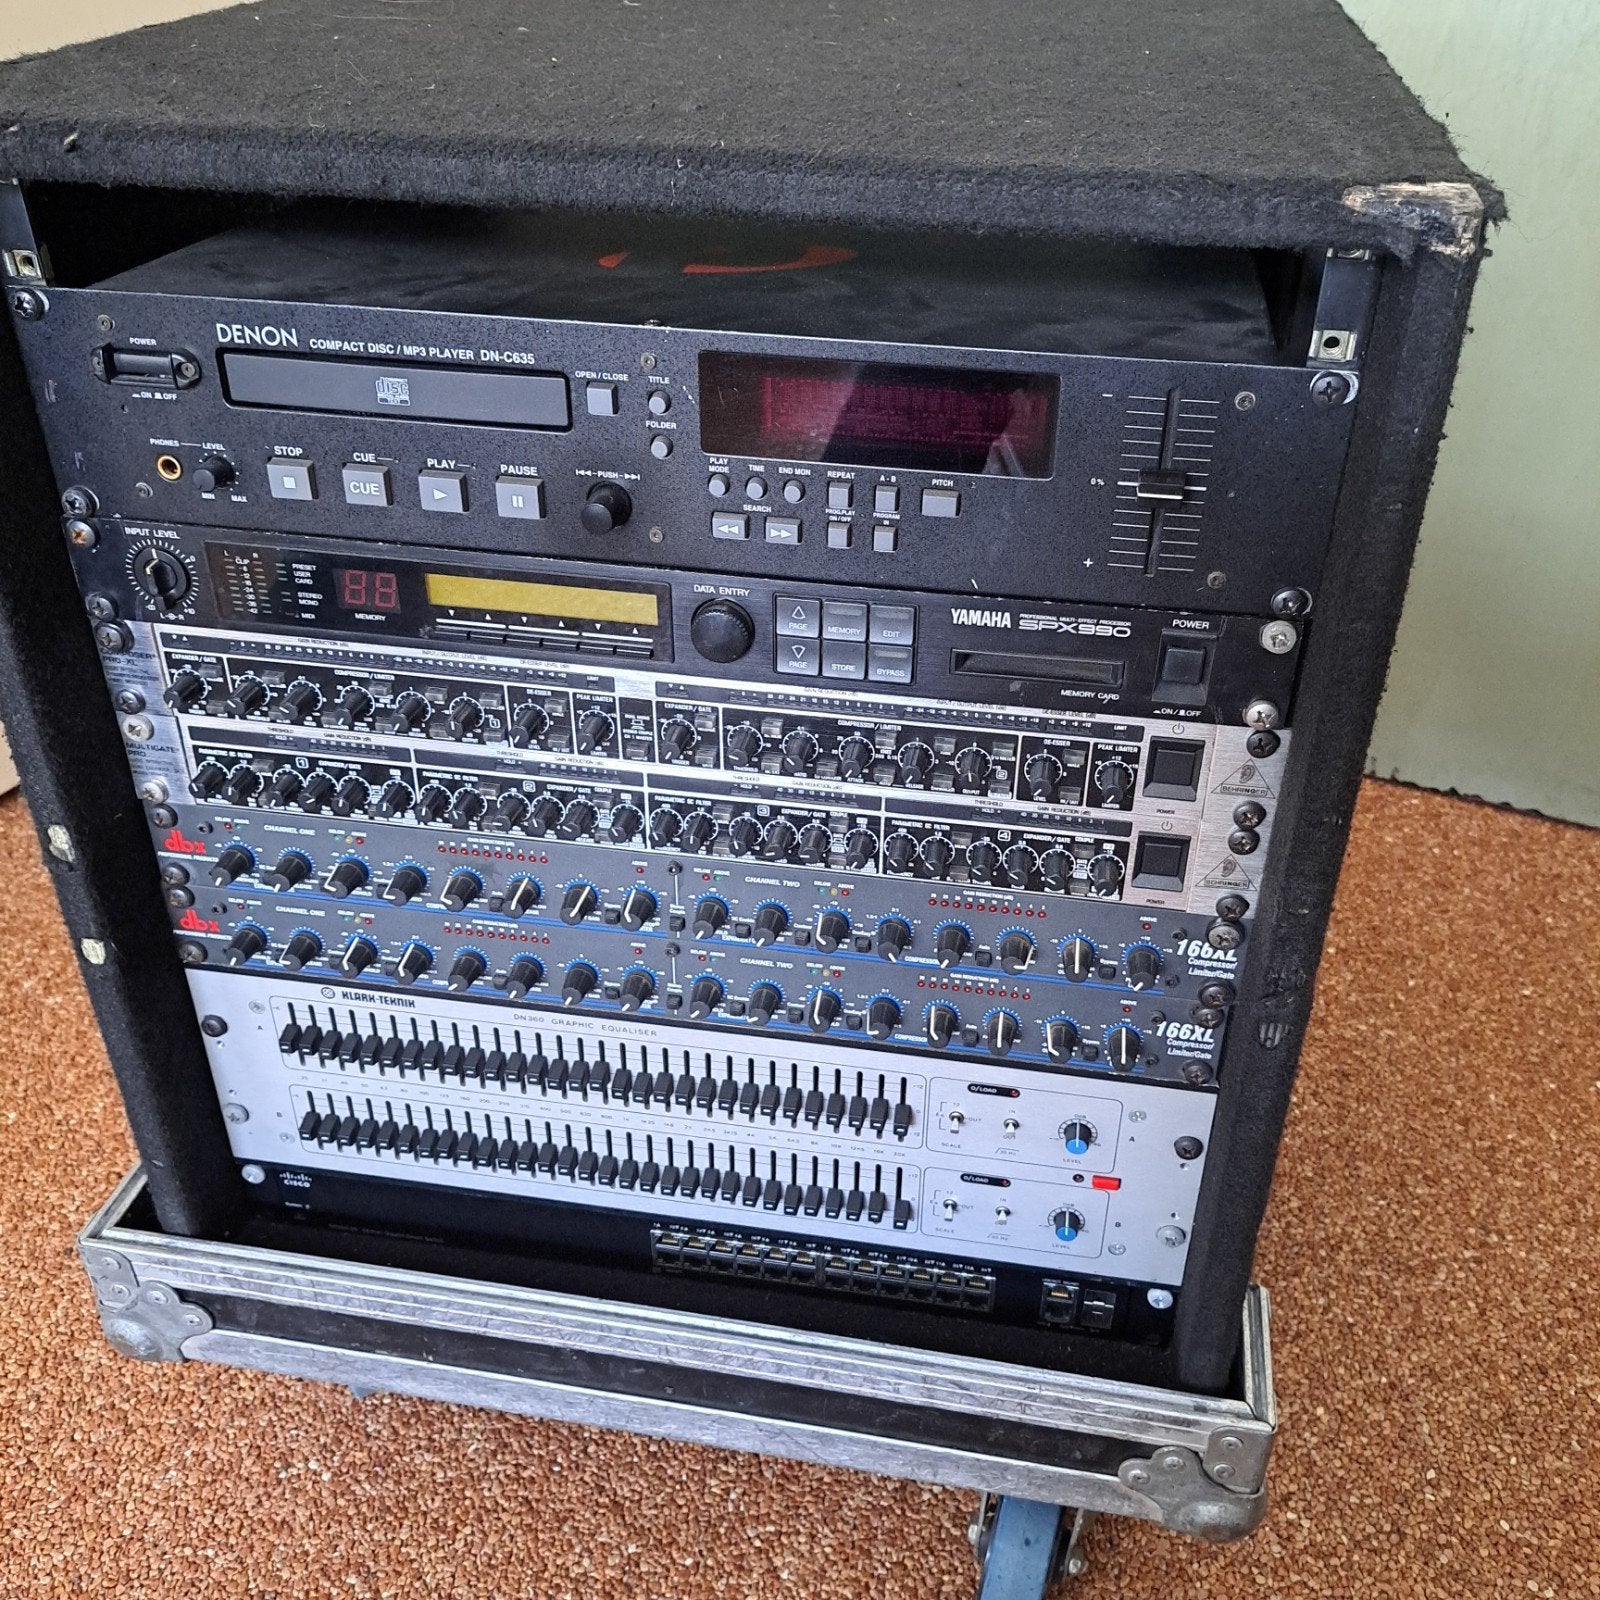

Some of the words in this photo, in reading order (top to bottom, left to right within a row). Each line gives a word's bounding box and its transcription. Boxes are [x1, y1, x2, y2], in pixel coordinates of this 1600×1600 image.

[129, 336, 157, 346] POWER
[216, 322, 299, 347] DENON
[310, 338, 364, 353] COMPACT
[368, 342, 394, 355] DISC
[403, 346, 427, 358] MP3
[429, 347, 474, 361] PLAYER
[480, 349, 535, 365] DN-C635
[575, 370, 597, 379] OPEN
[603, 372, 629, 382] CLOSE
[648, 375, 670, 385] TITLE
[141, 391, 152, 399] ON
[163, 393, 178, 401] OFF
[645, 420, 677, 430] FOLDER
[150, 438, 180, 447] PHONES
[202, 442, 225, 451] LEVEL
[274, 445, 303, 457] STOP
[353, 452, 376, 463] CUE
[709, 457, 728, 466] PLAY
[427, 458, 455, 471] PLAY
[708, 465, 729, 474] MODE
[748, 464, 765, 473] TIME
[500, 464, 538, 477] PAUSE
[597, 471, 619, 480] PUSH
[778, 466, 793, 475] END
[794, 467, 811, 476] MON
[827, 470, 855, 480] REPEAT
[349, 481, 380, 496] CUE
[931, 479, 954, 488] PITCH
[202, 492, 215, 500] MIN
[231, 495, 247, 503] MAX
[743, 503, 772, 514] SEARCH
[872, 511, 900, 520] PROGRAM
[125, 527, 150, 537] INPUT
[153, 530, 180, 540] LEVEL
[291, 562, 317, 572] PRESET
[293, 570, 311, 578] USER
[294, 577, 313, 585] CARD
[297, 591, 323, 600] STEREO
[693, 584, 716, 594] DATA
[719, 586, 750, 598] ENTRY
[298, 598, 319, 606] MONO
[354, 613, 386, 622] MEMORY
[951, 607, 1012, 629] YAMAHA
[788, 622, 808, 631] PAGE
[1018, 619, 1132, 639] SPX990
[1172, 618, 1210, 630] POWER
[827, 626, 861, 636] MEMORY
[882, 630, 901, 638] EDIT
[788, 660, 808, 669] PAGE
[831, 663, 856, 672] STORE
[876, 668, 905, 677] BYPASS
[1061, 689, 1096, 699] MEMORY
[1097, 691, 1120, 701] CARD
[1160, 707, 1173, 716] ON
[1185, 710, 1202, 718] OFF
[1222, 785, 1267, 795] BEHRINGER
[164, 829, 207, 854] dbx
[745, 876, 781, 886] CHANNEL
[782, 880, 801, 888] TWO
[1205, 879, 1249, 888] BEHRINGER
[275, 905, 309, 915] CHANNEL
[179, 908, 221, 933] dbx
[1139, 915, 1158, 923] ABOVE
[740, 957, 775, 968] CHANNEL
[776, 962, 794, 970] TWO
[1187, 957, 1238, 970] Compressor/
[1188, 967, 1235, 980] Limiter/Gate
[341, 990, 416, 1009] KLARK-TEKNIK
[513, 1013, 545, 1023] DN360
[551, 1018, 594, 1030] GRAPHIC
[601, 1024, 657, 1037] EQUALISER
[1156, 1021, 1215, 1044] 166XL
[1166, 1037, 1215, 1051] Compressor/
[1167, 1047, 1212, 1060] Limiter/Gate
[970, 1084, 997, 1095] O/LOAD
[941, 1142, 961, 1150] SCALE
[283, 1179, 311, 1188] cisco
[963, 1174, 989, 1184] O/LOAD
